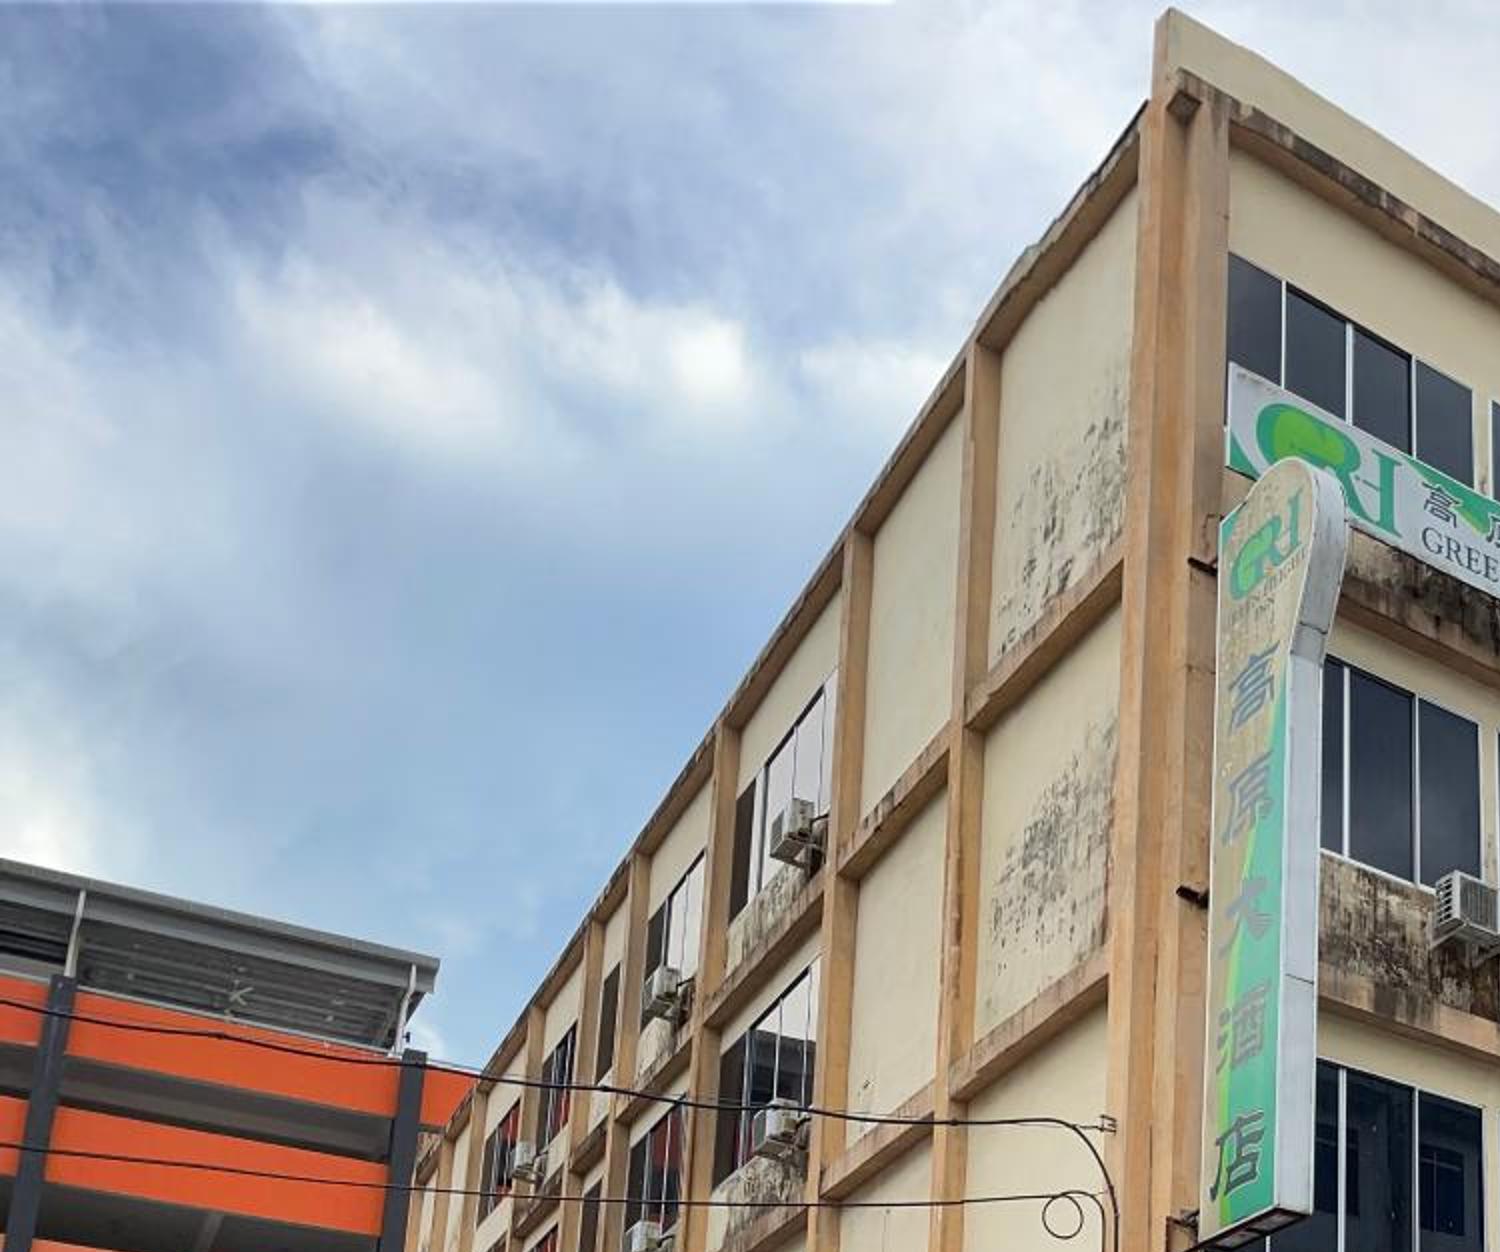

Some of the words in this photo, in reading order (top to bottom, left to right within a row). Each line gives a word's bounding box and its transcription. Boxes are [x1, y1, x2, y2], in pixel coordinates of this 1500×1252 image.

[1210, 640, 1281, 1202] 高原大酒店
